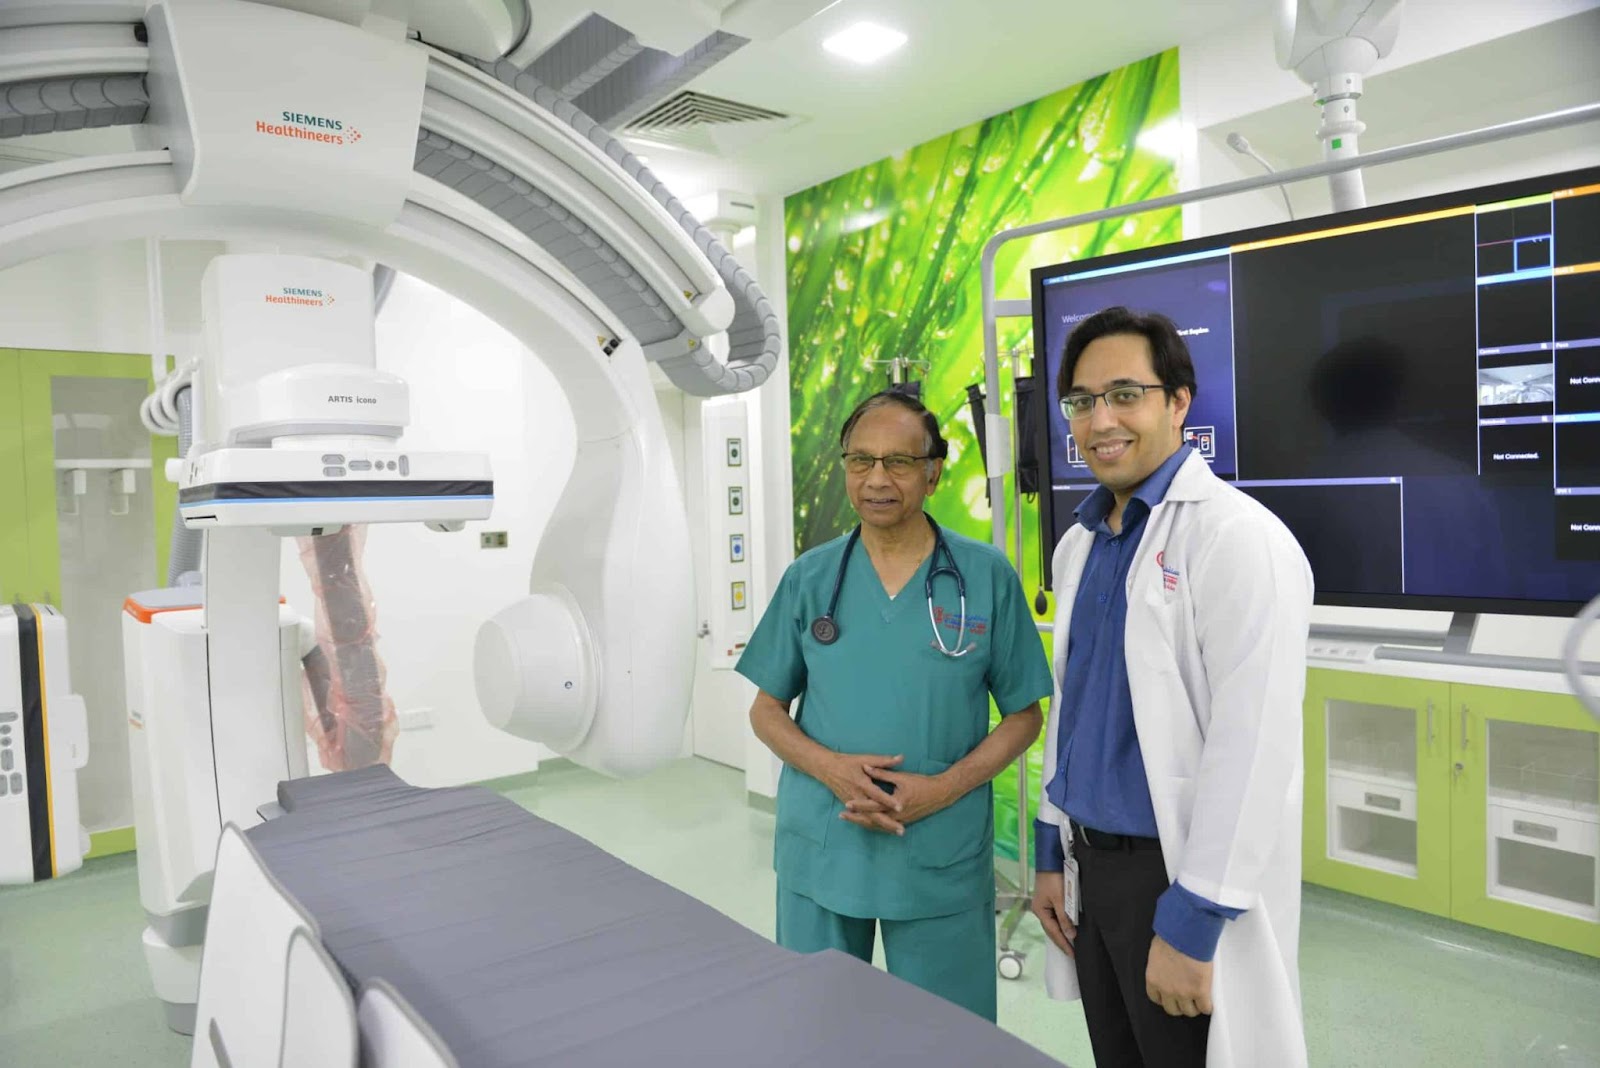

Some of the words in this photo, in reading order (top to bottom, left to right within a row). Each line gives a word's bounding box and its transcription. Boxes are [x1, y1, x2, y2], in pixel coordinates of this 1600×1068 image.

[282, 111, 343, 130] SIEMENS
[256, 120, 344, 145] Healthineers
[283, 287, 323, 297] SIEMENS
[265, 294, 323, 306] Healthineers
[328, 395, 353, 403] ARTIS
[356, 395, 377, 404] icono
